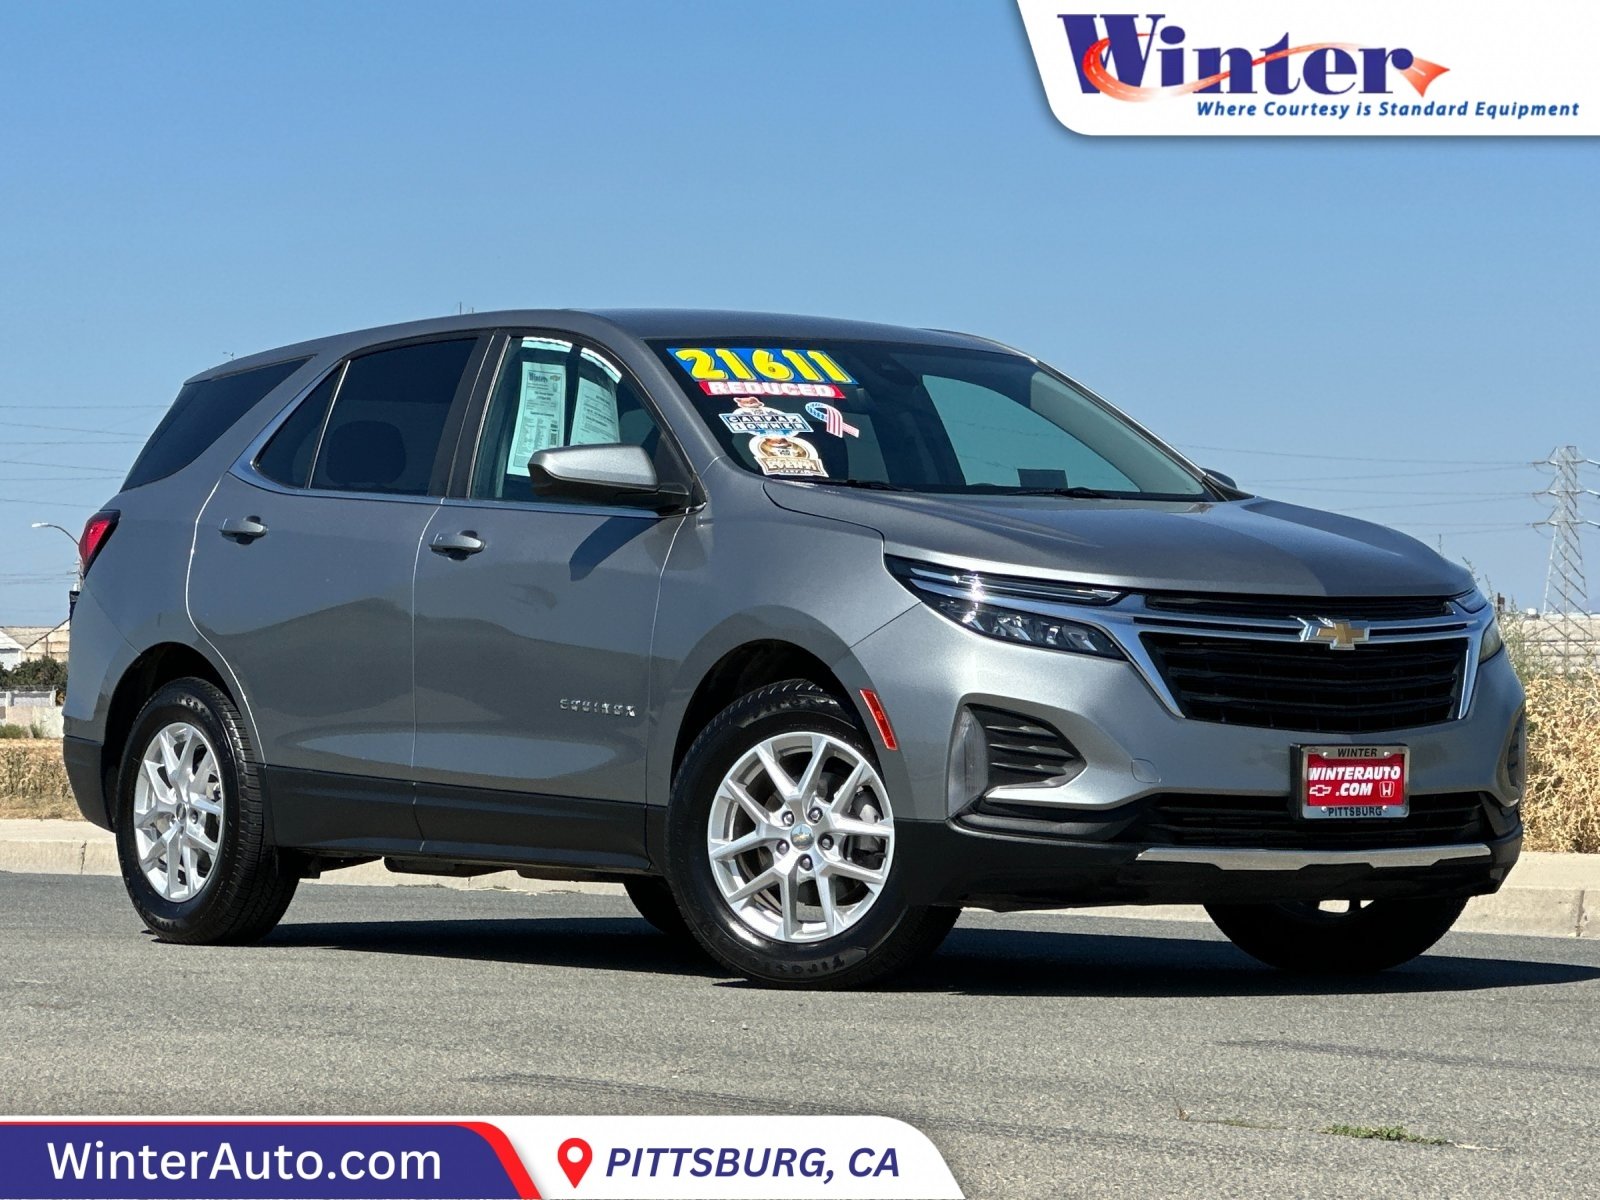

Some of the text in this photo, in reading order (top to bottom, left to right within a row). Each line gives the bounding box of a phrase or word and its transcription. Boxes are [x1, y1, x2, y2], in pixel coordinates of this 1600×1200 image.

[676, 348, 852, 381] 21611
[708, 382, 836, 398] REDUCED
[1337, 748, 1378, 757] WINTER
[1309, 766, 1401, 781] WINTERAUTO
[1335, 782, 1374, 797] .COM
[1328, 806, 1382, 817] PITTSBURG
